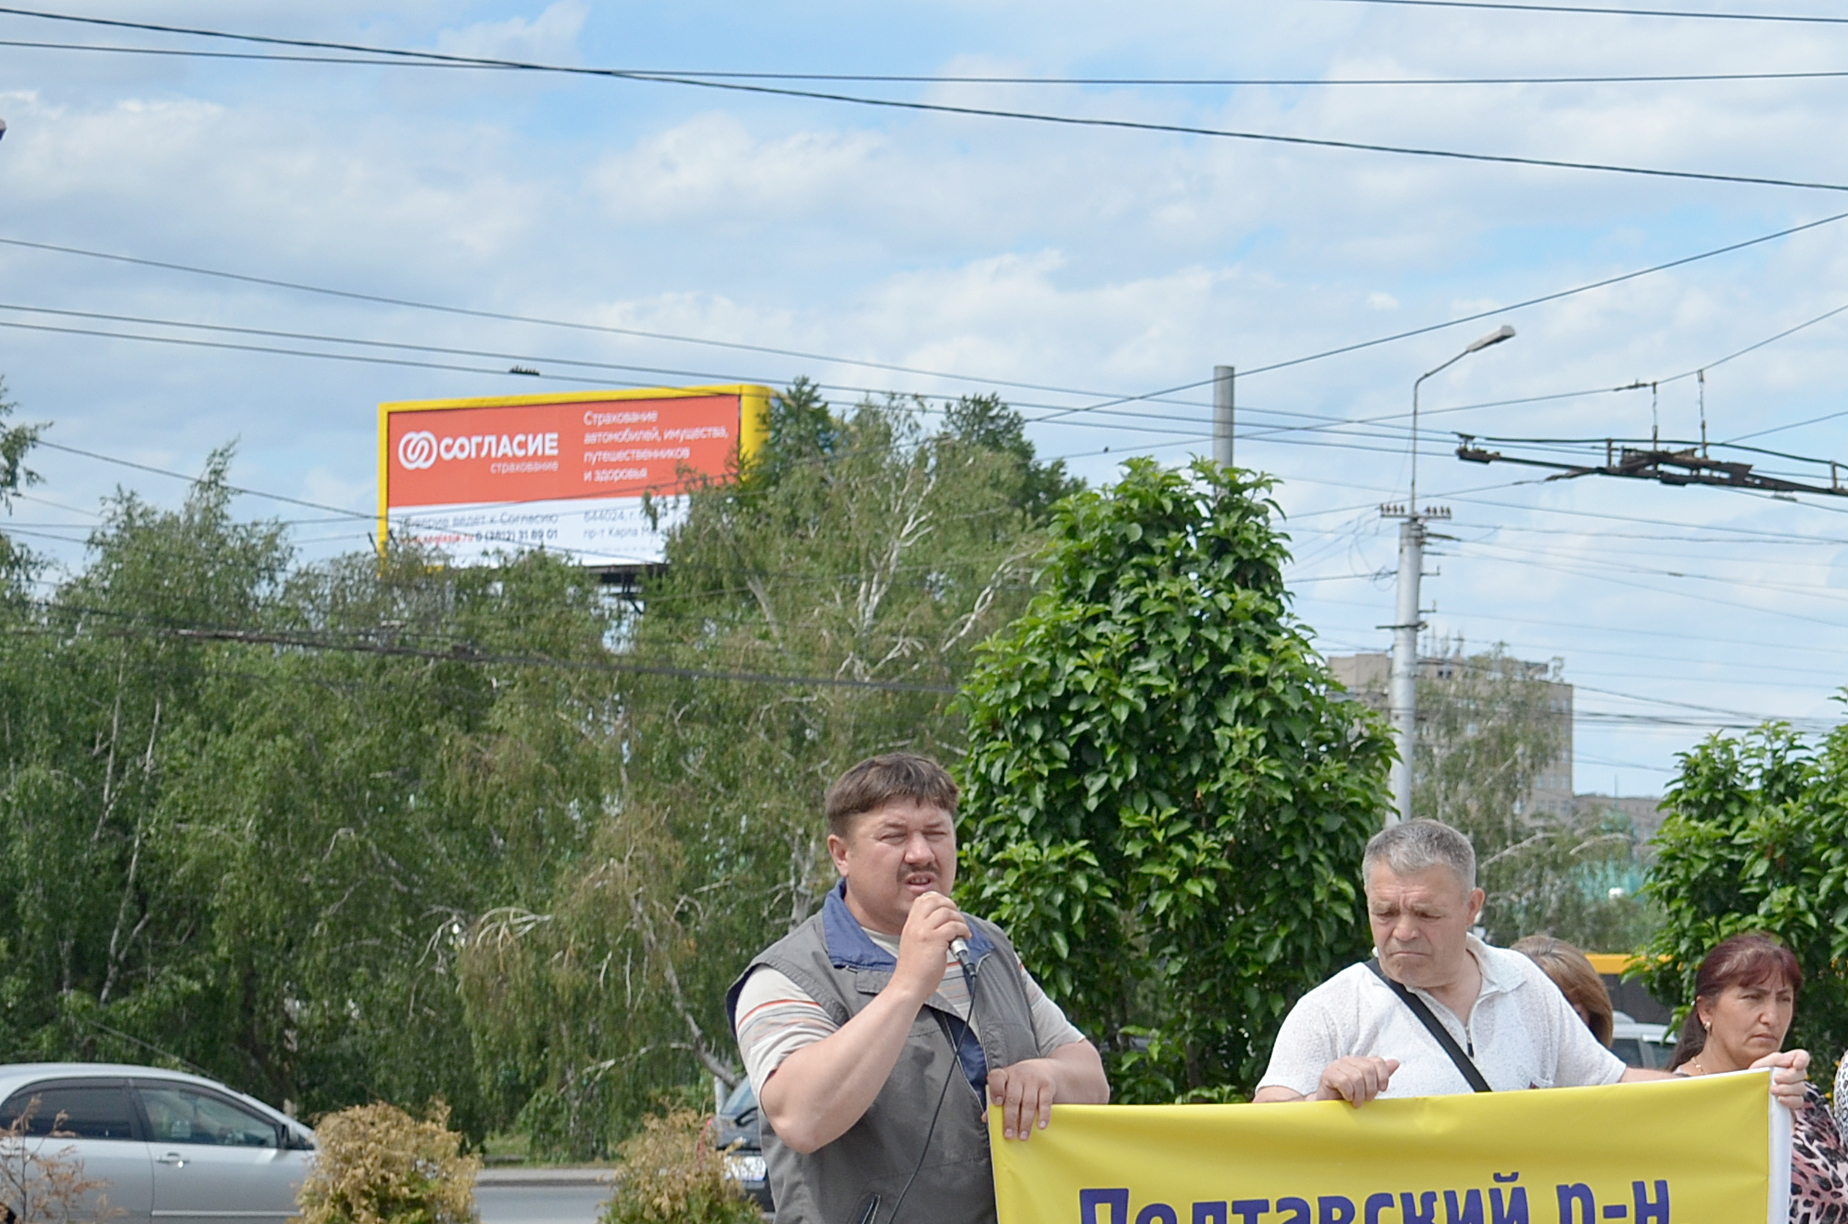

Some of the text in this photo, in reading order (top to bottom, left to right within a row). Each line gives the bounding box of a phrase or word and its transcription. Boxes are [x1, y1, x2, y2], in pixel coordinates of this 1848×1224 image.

[584, 410, 658, 427] Страхование
[584, 426, 729, 444] автомобилей, имущества,
[439, 431, 559, 461] СОГЛАСИЕ
[584, 447, 690, 466] путешественников
[490, 461, 559, 474] страхование
[584, 467, 648, 482] и здоровья
